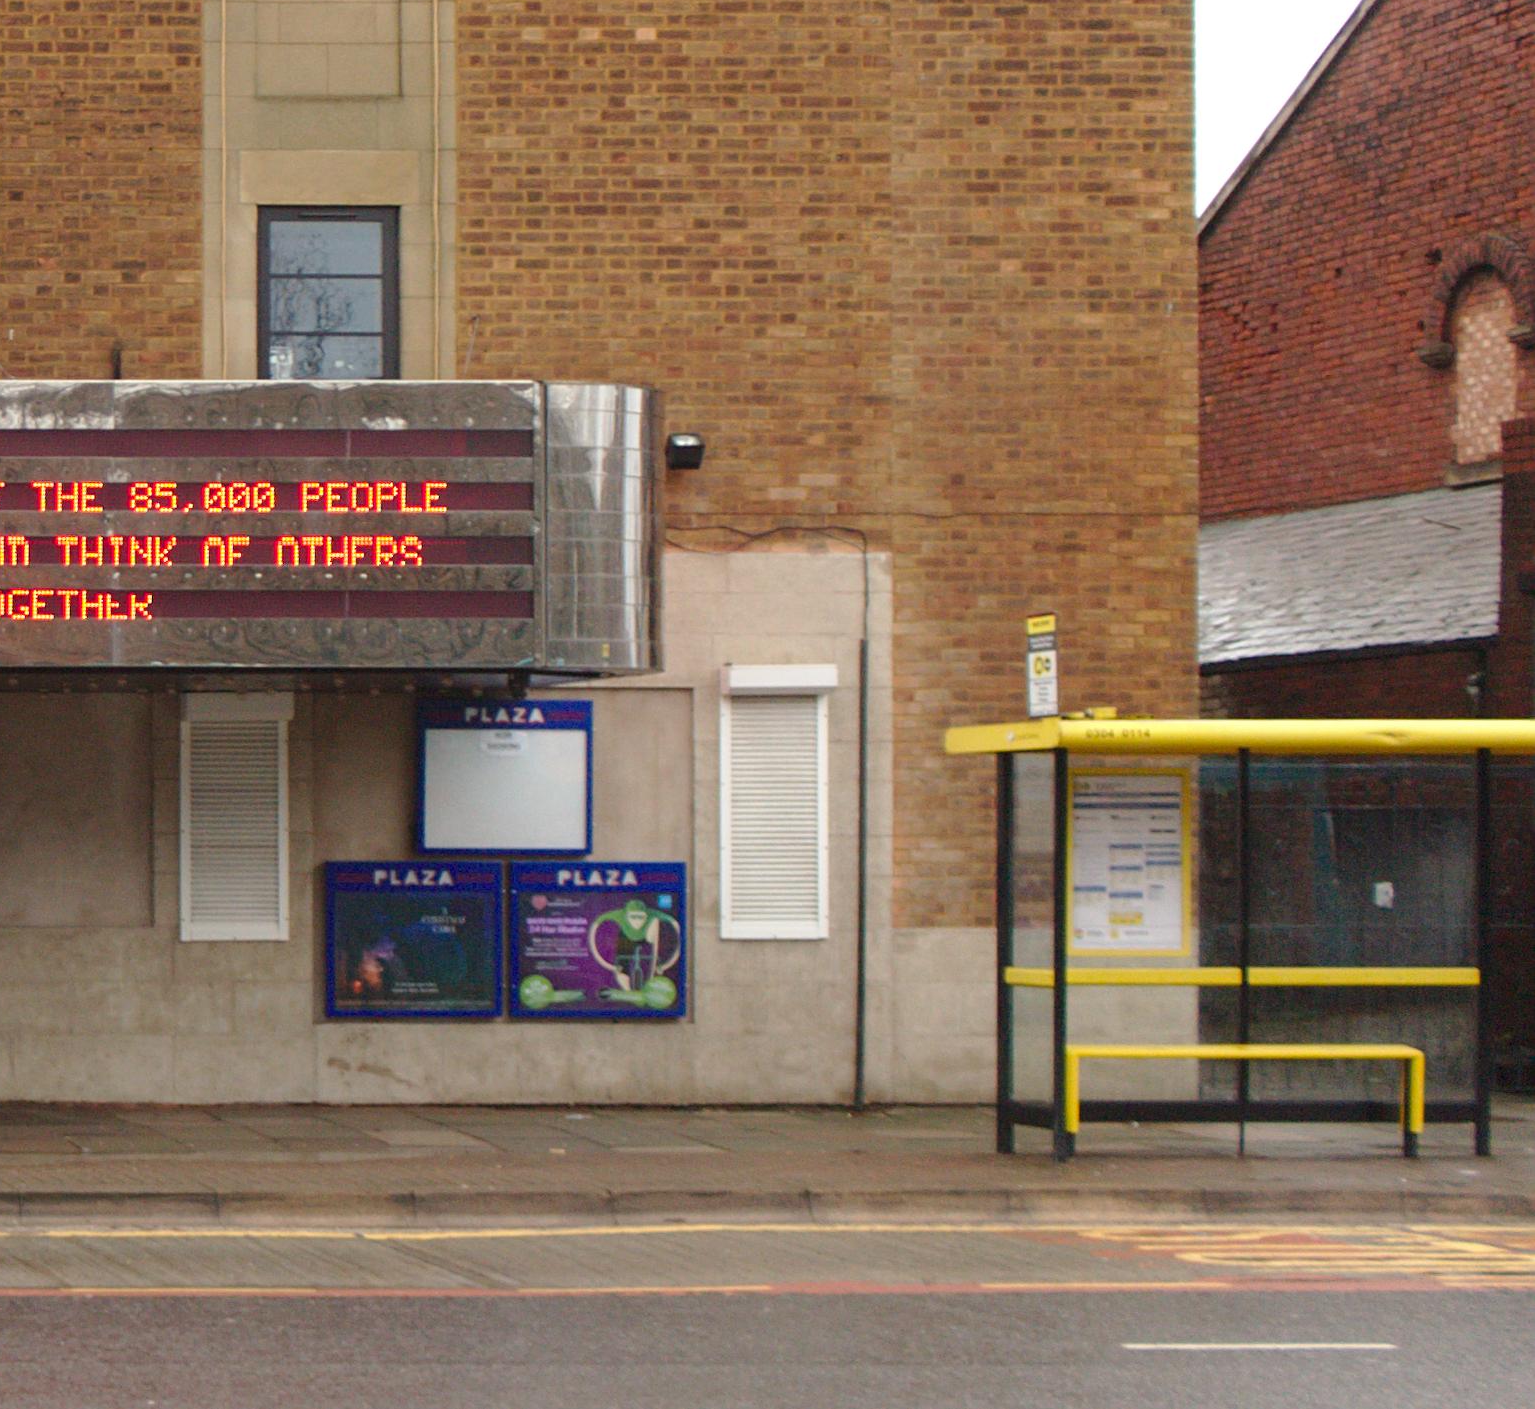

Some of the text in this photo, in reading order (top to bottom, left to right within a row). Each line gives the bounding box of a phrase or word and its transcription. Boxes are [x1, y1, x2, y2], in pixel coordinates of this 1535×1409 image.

[31, 480, 104, 513] THE
[128, 482, 275, 513] 85,000
[299, 481, 448, 514] PEOPLE
[54, 533, 177, 567] THINK
[464, 707, 545, 723] PLAZA
[373, 869, 454, 886] PLAZA
[557, 869, 638, 886] PLAZA
